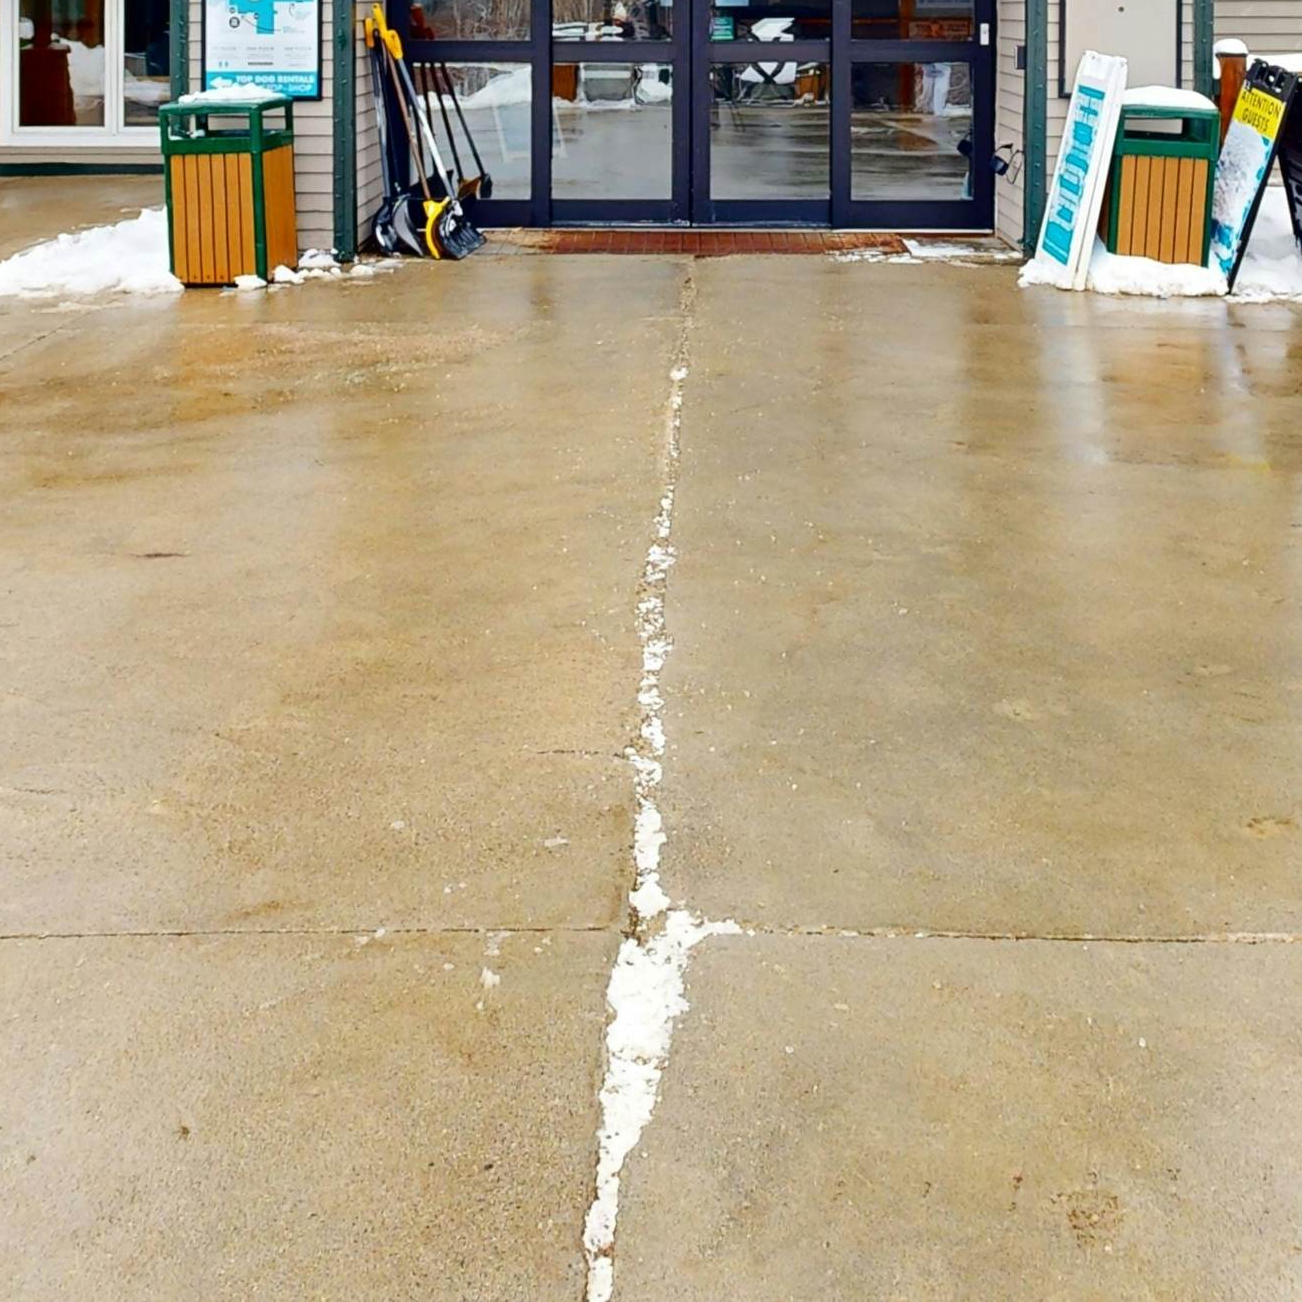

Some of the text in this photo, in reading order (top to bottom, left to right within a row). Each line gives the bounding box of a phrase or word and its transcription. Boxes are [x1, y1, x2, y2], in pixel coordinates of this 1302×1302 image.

[236, 75, 315, 84] TOP DOG RENTALS
[1241, 90, 1282, 118] ATTENTION
[1242, 107, 1270, 132] GUESTS
